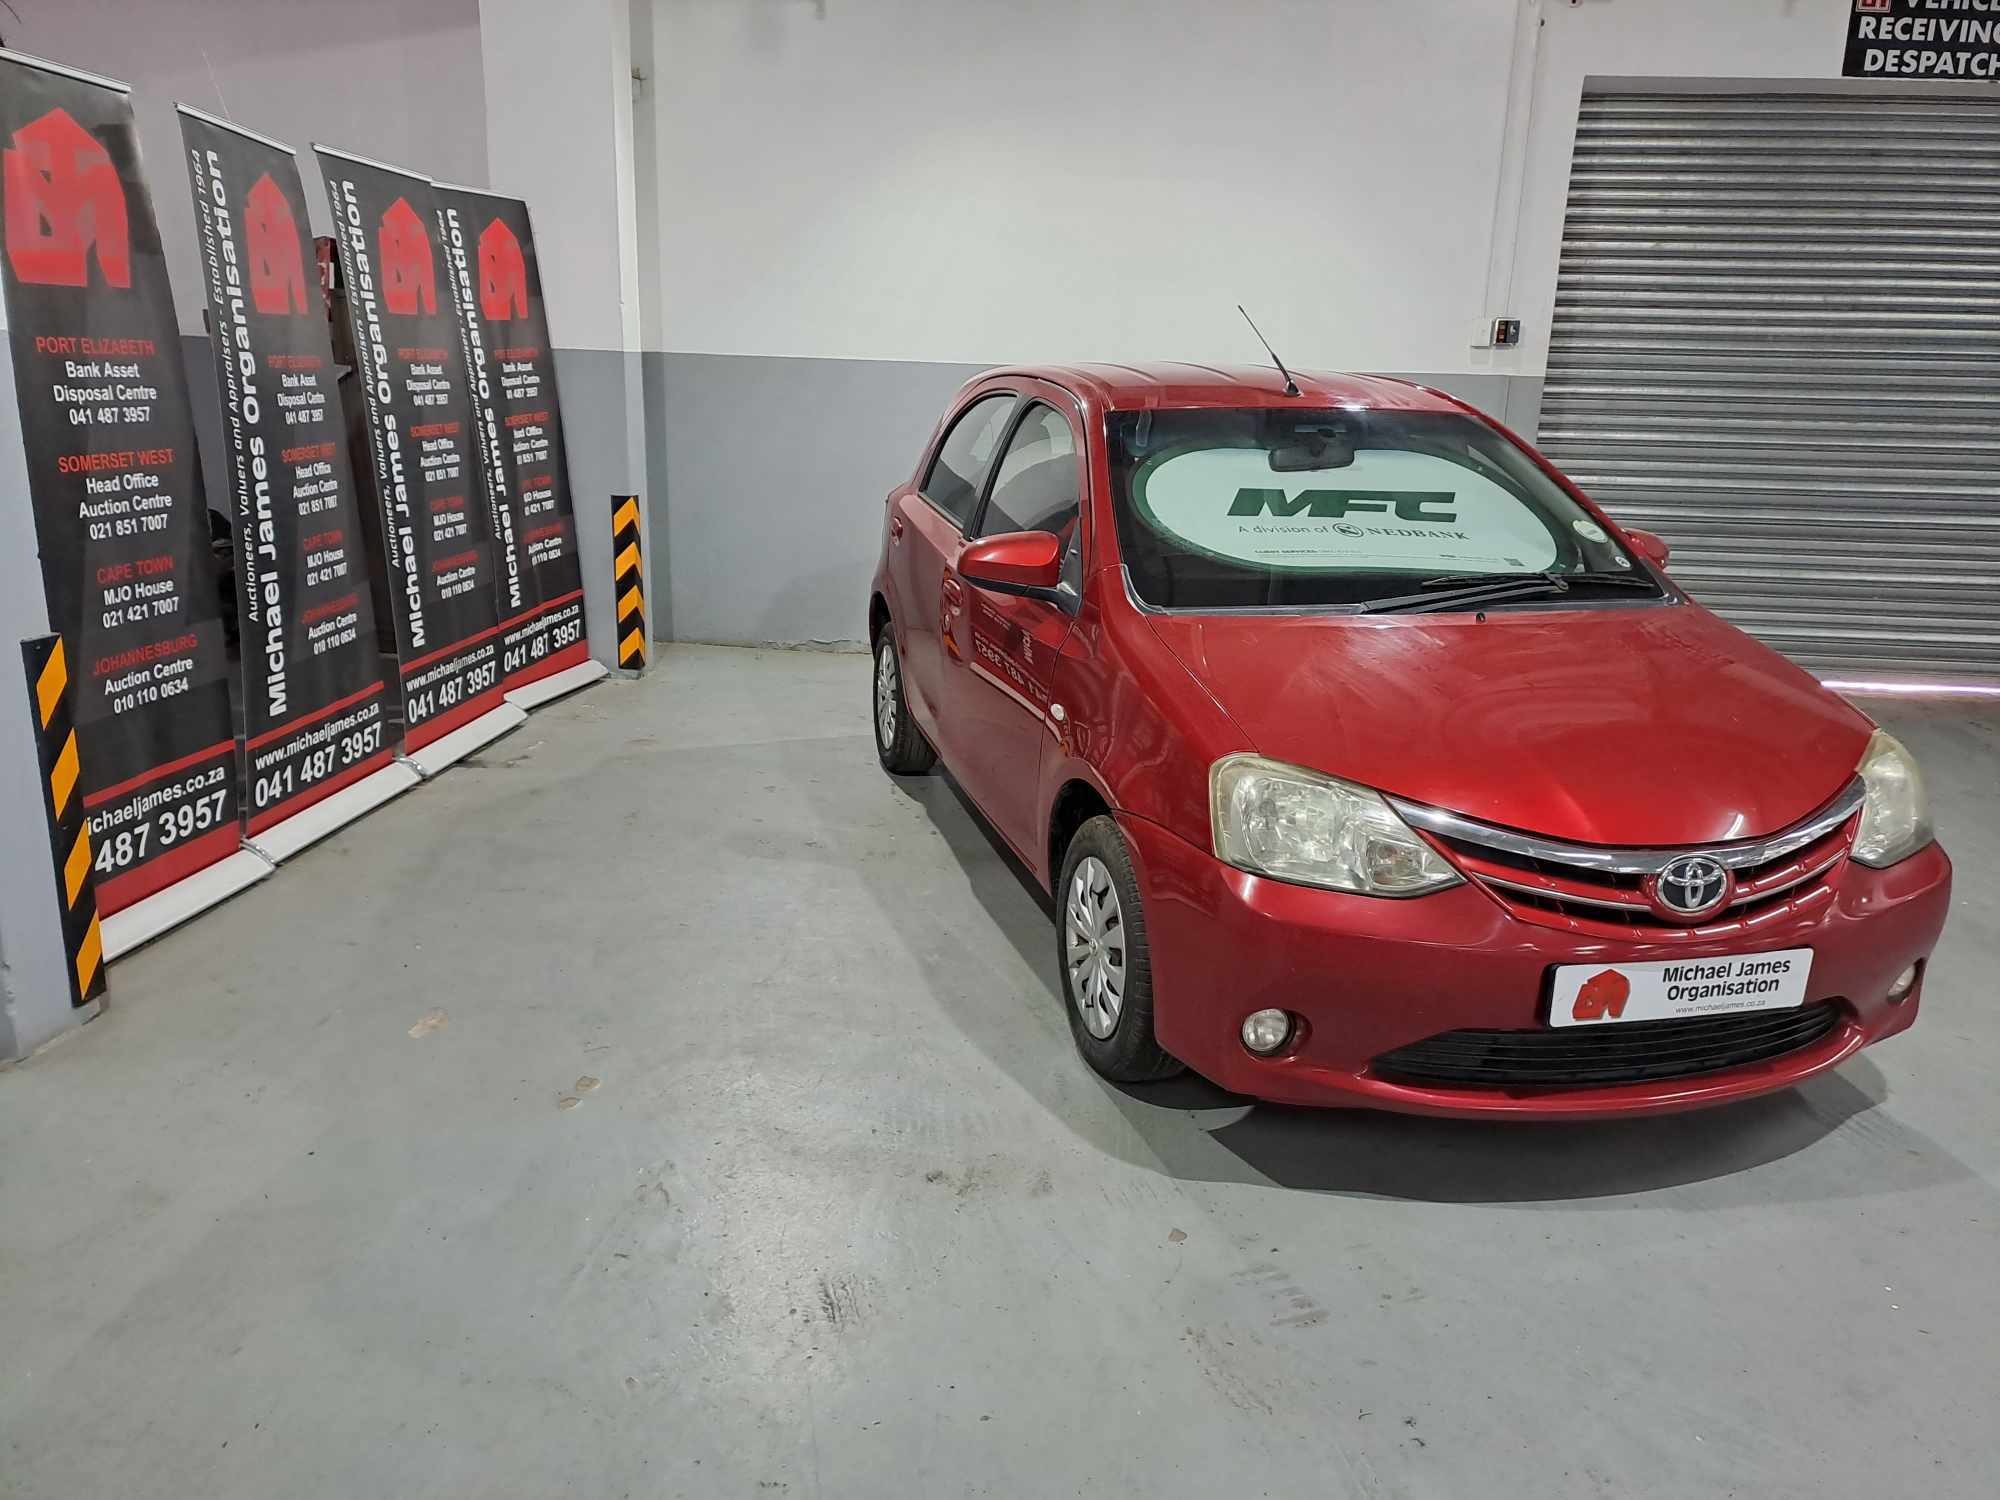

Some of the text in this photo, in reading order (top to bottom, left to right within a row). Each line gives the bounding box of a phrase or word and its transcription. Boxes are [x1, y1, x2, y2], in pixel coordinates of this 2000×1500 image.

[191, 148, 208, 195] 1964
[199, 199, 225, 305] Established
[35, 336, 156, 356] PORT ELIZABETH
[356, 319, 375, 395] Appraisers
[65, 361, 140, 378] Bank Asset
[216, 320, 240, 414] Appraisers
[53, 385, 157, 405] Disposal Centre
[277, 393, 306, 408] Disposal
[445, 208, 521, 608] Michael James Organisation
[472, 394, 481, 418] and
[69, 406, 151, 425] 041 487 3957
[285, 411, 297, 425] 041
[298, 410, 309, 424] 487
[341, 179, 426, 648] Michael James Organisation
[369, 397, 379, 425] and
[205, 150, 287, 718] Michael James Organisation
[228, 417, 243, 450] and
[57, 448, 174, 473] SOMERSET WEST
[373, 428, 388, 480] Valuers
[86, 473, 159, 494] Head Office
[235, 454, 250, 517] Valuers
[295, 465, 312, 479] Head
[78, 494, 172, 519] Auction Centre
[293, 483, 318, 499] Auction
[1227, 487, 1457, 523] MFC
[298, 502, 310, 516] 021
[311, 498, 323, 513] 851
[89, 513, 168, 540] 021 851 7007
[383, 485, 400, 568] Auctioneers,
[1239, 525, 1470, 541] A division of NEDBANK
[97, 555, 173, 585] CAPE TOWN
[323, 549, 344, 563] House
[240, 523, 260, 622] Auctioneers,
[306, 573, 318, 586] 021
[320, 568, 332, 582] 421
[103, 577, 174, 607] MJO House
[103, 596, 179, 629] 021 421 7007
[503, 604, 579, 646] www.michaeljames.co.za
[308, 621, 335, 640] Auction
[313, 641, 326, 655] 010
[327, 634, 340, 650] 110
[504, 619, 581, 673] 041 487 3957
[93, 633, 198, 677] JOHANNESBURG
[406, 645, 494, 692] www.michaeljames.co.za
[104, 657, 193, 696] Auction Centre
[408, 661, 496, 723] 041 487 3957
[113, 676, 189, 714] 010 110 0634
[255, 701, 380, 771] www.michaeljames.co.za
[255, 721, 383, 809] 041 487 3957
[87, 766, 225, 836] ichaeljames.co.za
[94, 789, 227, 873] 487 3957
[1662, 958, 1790, 983] Michael James
[1667, 977, 1779, 1002] Organisation
[1675, 1000, 1765, 1014] www.michaeljames.co.za
